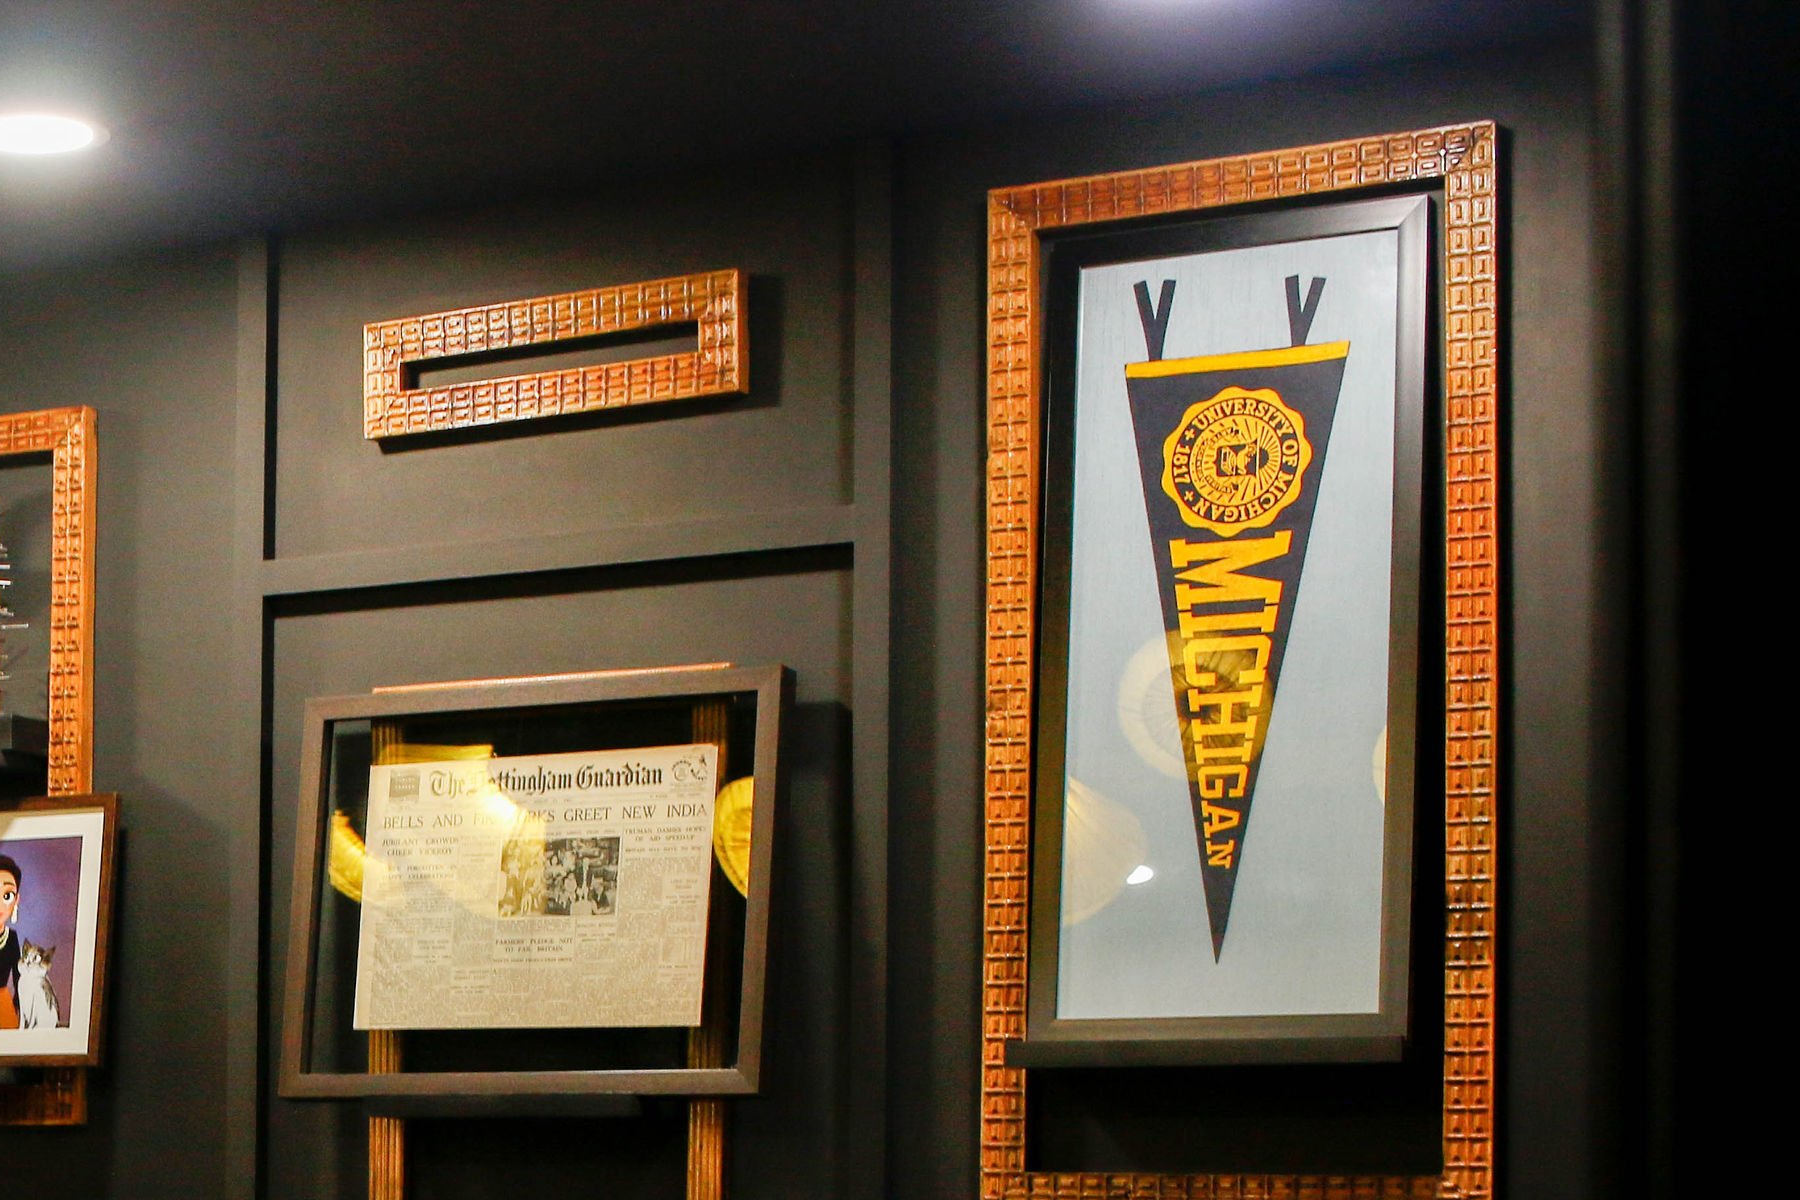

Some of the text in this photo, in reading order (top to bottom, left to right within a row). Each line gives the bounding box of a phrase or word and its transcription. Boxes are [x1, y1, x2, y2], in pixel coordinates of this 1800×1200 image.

[1191, 398, 1294, 436] UNIVERSITY
[1173, 443, 1191, 485] 1817
[1281, 438, 1299, 467] OF
[1192, 471, 1294, 523] MICHIGAN
[1168, 529, 1294, 870] MICHIGAN
[429, 769, 465, 800] The
[466, 764, 572, 796] ottingham
[576, 761, 663, 790] Guardian
[383, 814, 425, 830] BELLS
[432, 812, 464, 828] AND
[563, 806, 613, 822] GREET
[622, 804, 657, 819] NEW
[666, 803, 708, 818] INDIA
